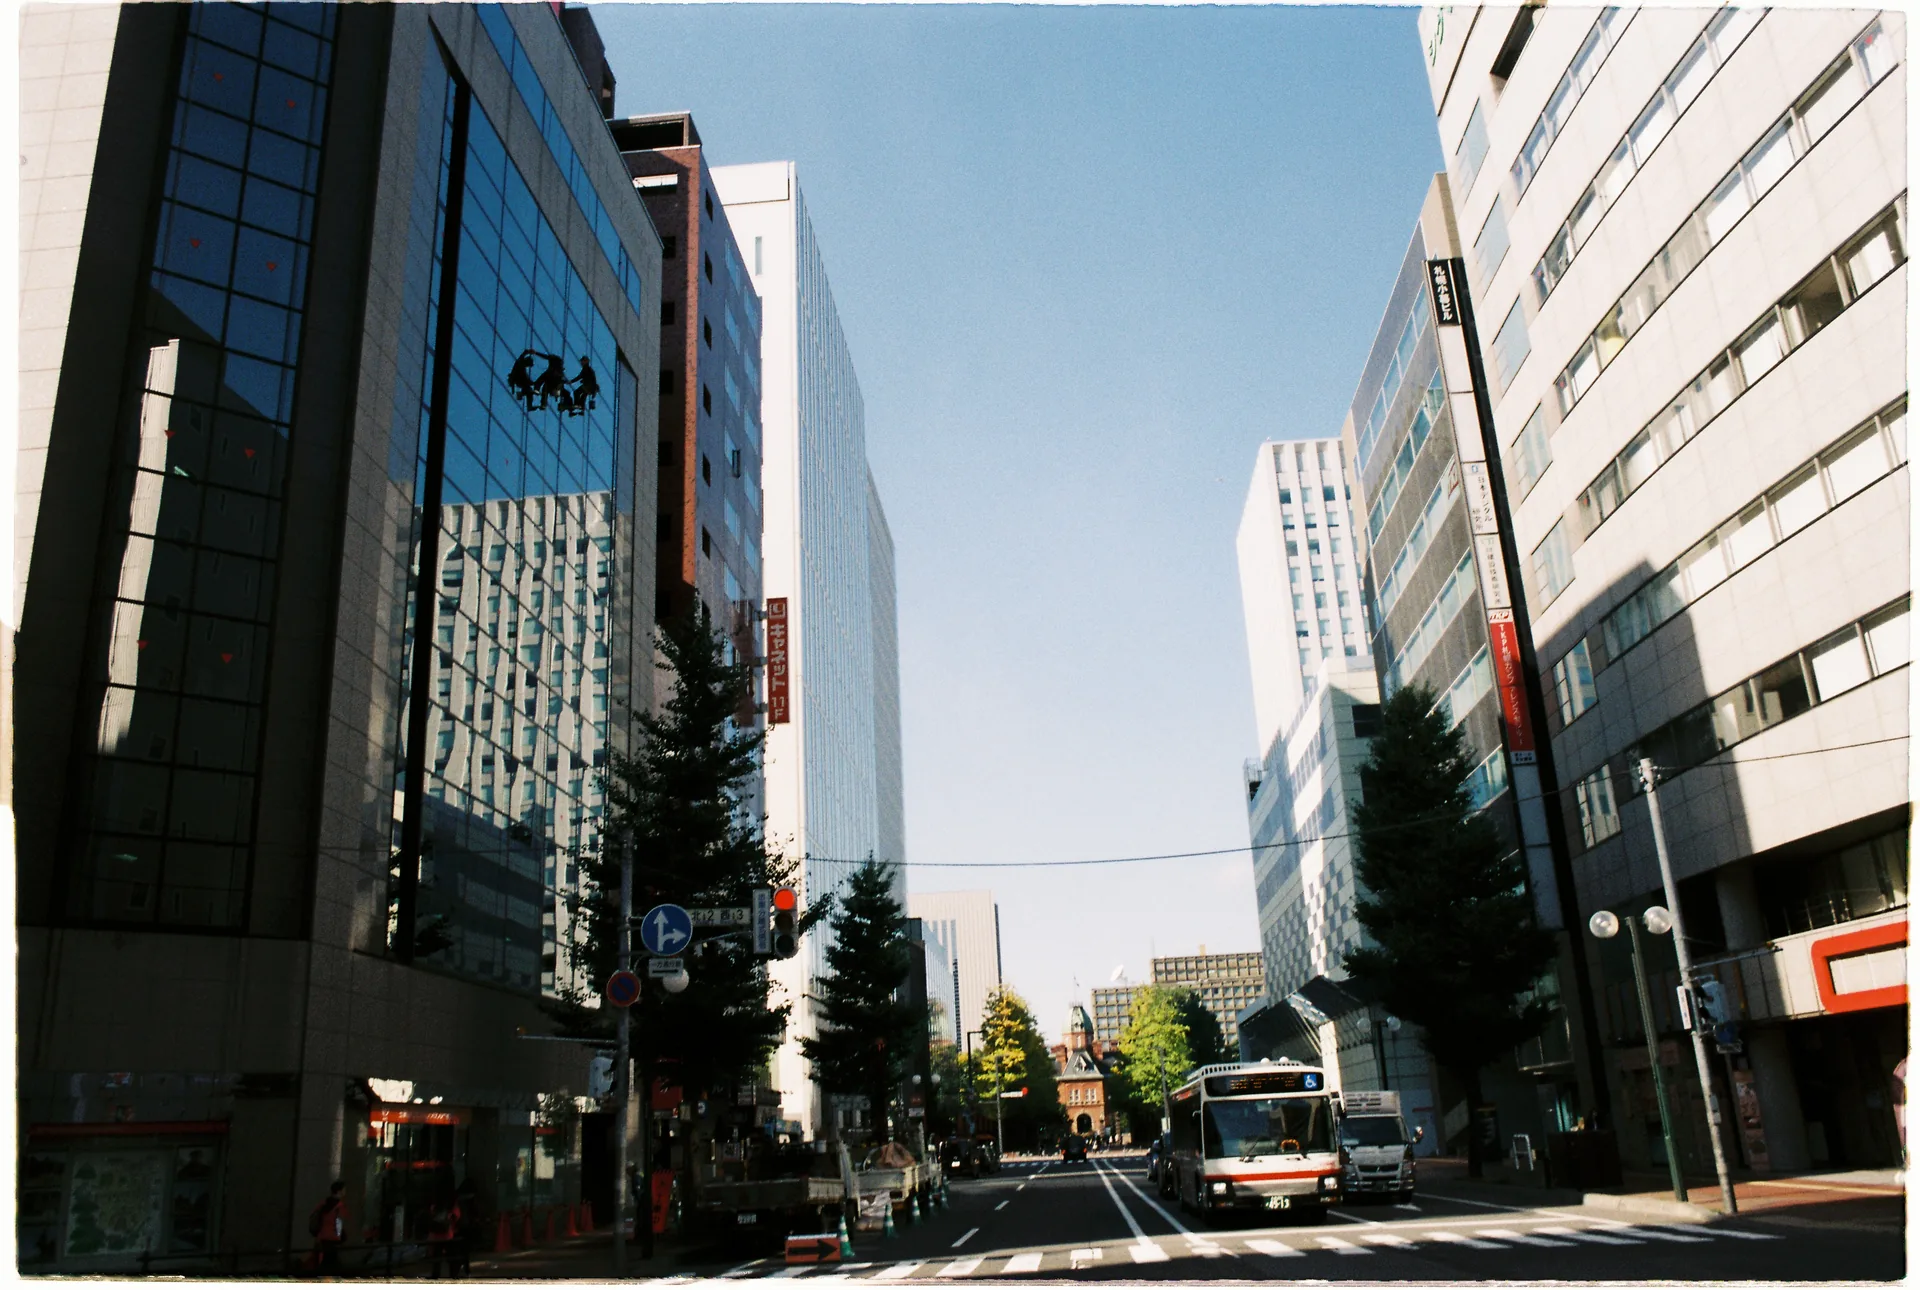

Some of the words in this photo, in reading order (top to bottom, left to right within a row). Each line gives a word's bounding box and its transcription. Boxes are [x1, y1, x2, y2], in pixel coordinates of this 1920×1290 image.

[769, 623, 786, 691] キャネット
